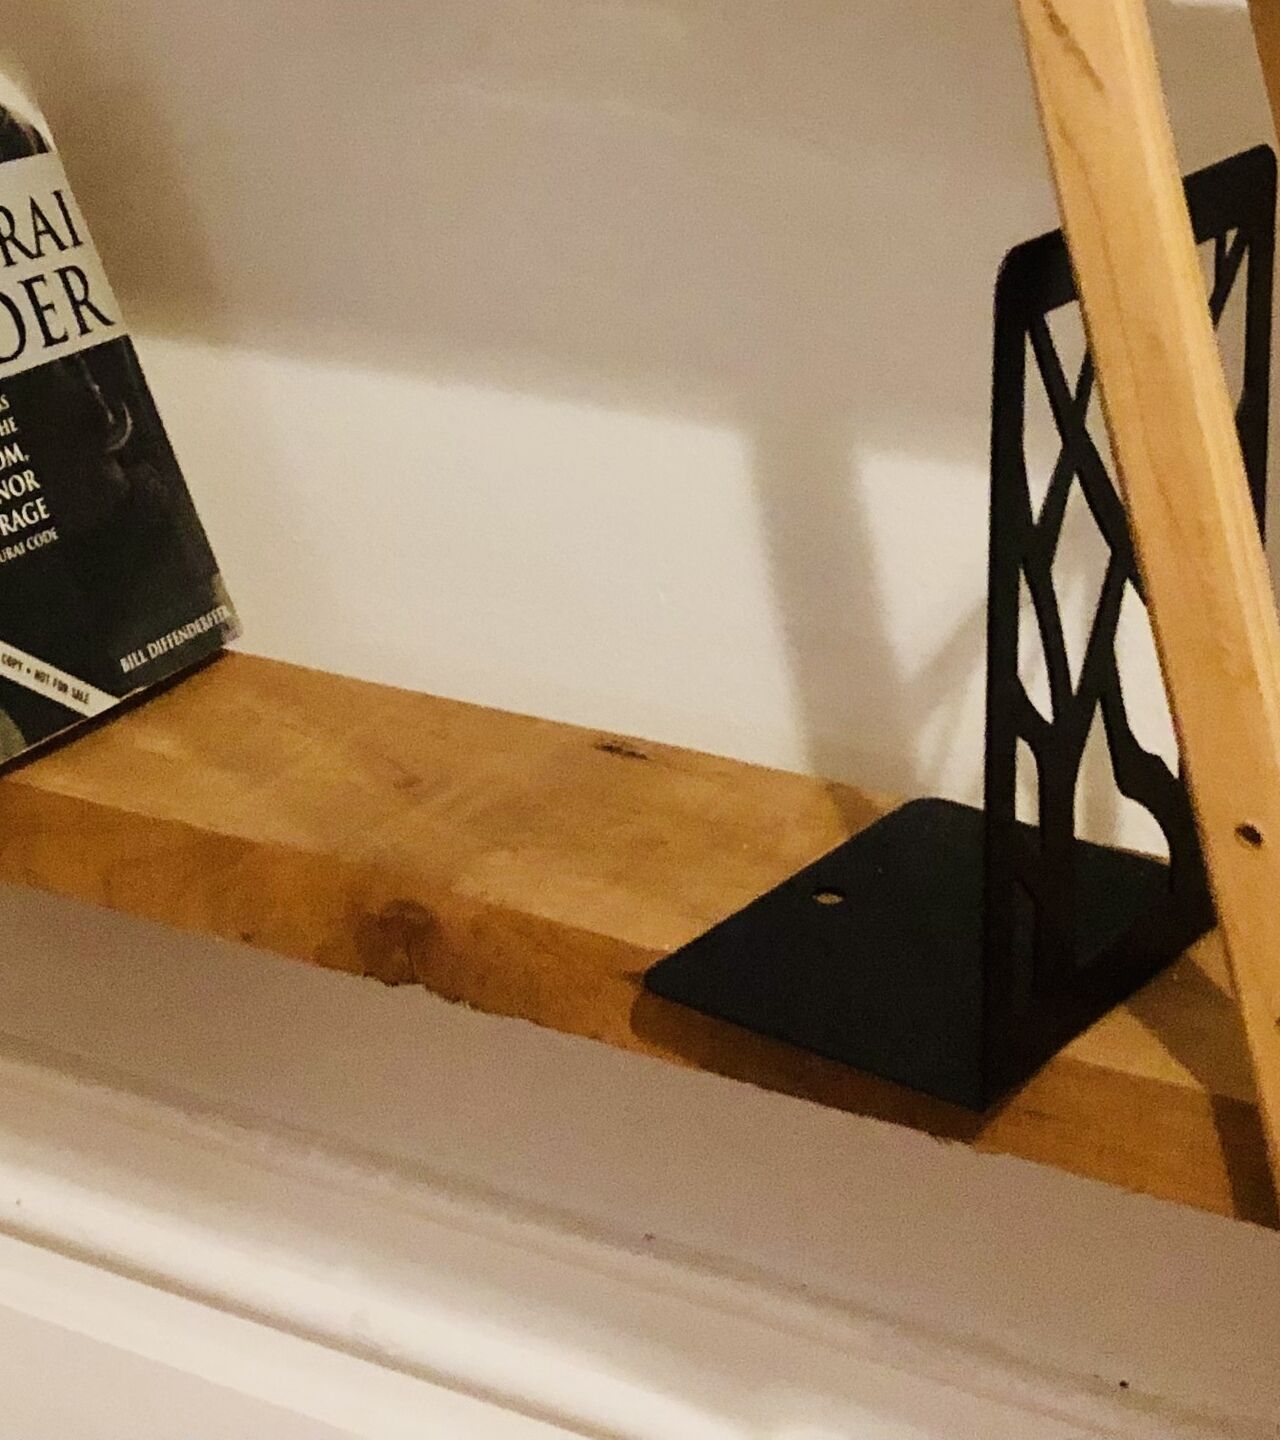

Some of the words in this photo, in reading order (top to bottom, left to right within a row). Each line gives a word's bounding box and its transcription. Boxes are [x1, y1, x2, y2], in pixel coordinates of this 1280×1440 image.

[26, 527, 59, 551] CODE
[120, 649, 148, 673] BILL
[1, 653, 24, 672] COPY
[33, 669, 51, 685] NOT
[52, 677, 69, 695] FOR
[71, 687, 91, 705] SALE
